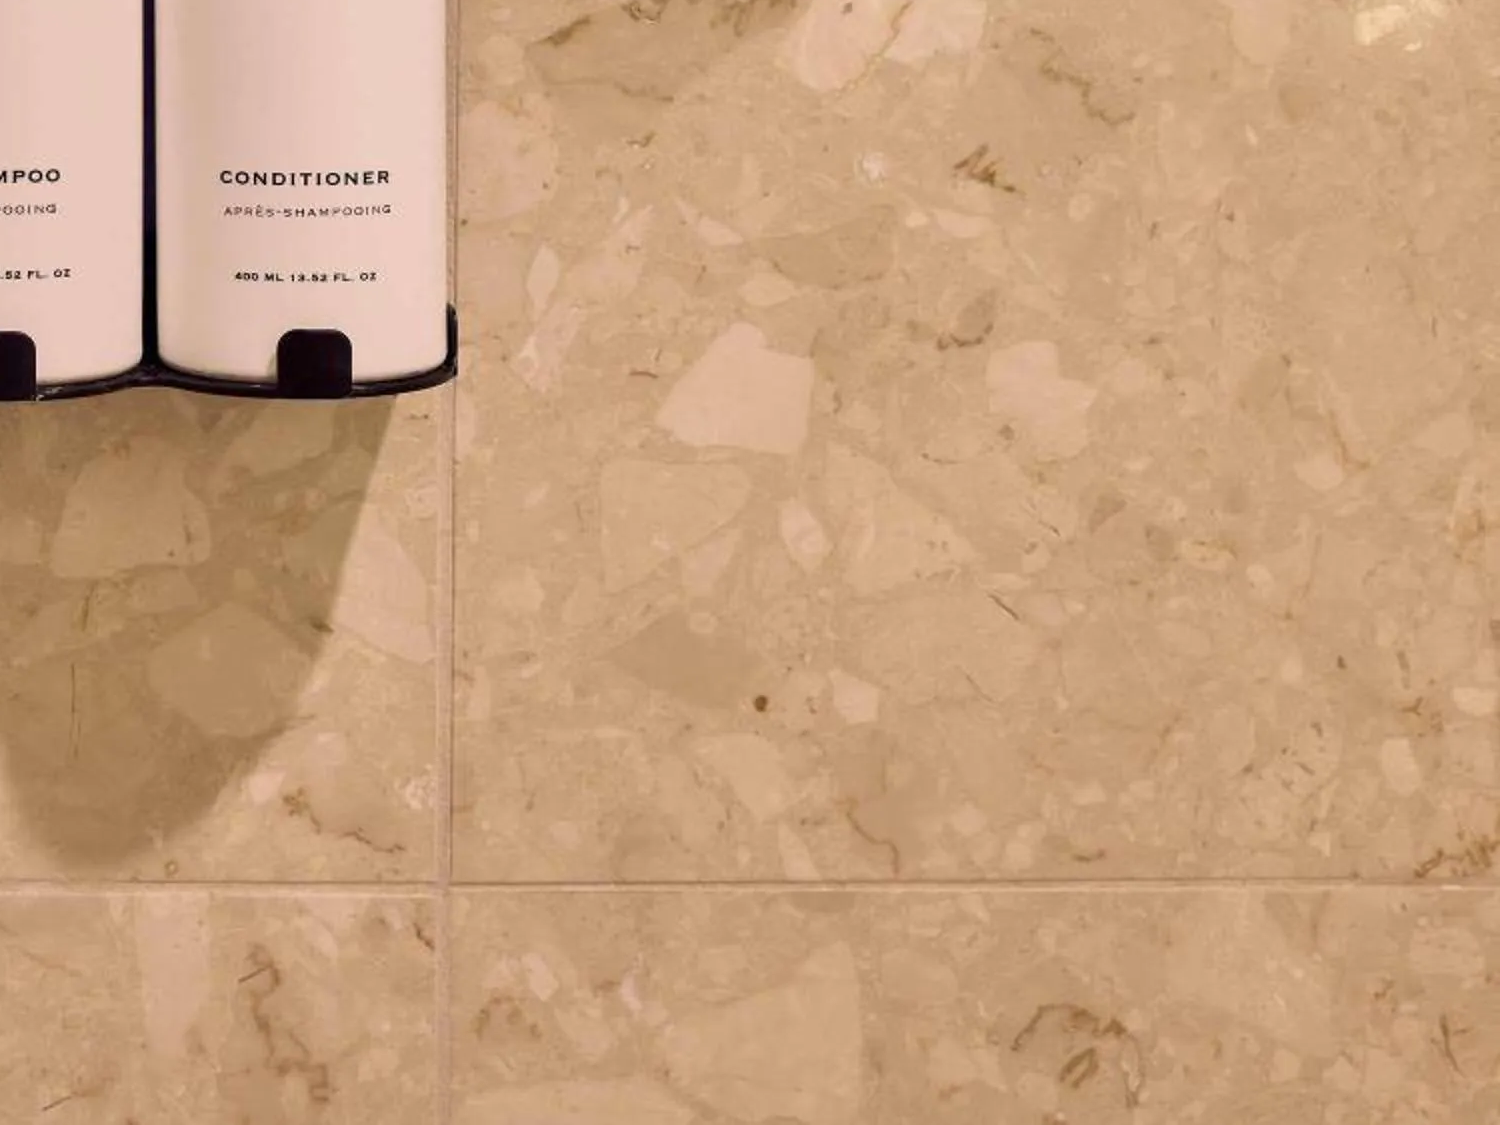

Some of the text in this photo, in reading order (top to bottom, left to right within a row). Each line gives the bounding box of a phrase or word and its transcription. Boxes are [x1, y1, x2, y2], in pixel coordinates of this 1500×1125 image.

[219, 170, 390, 187] CONDITIONER
[223, 203, 392, 218] APRÈS-SHAMPOOING
[52, 268, 72, 279] OZ
[234, 271, 260, 282] 400
[263, 272, 285, 283] ML
[290, 272, 329, 283] 13.52
[358, 271, 378, 282] OZ
